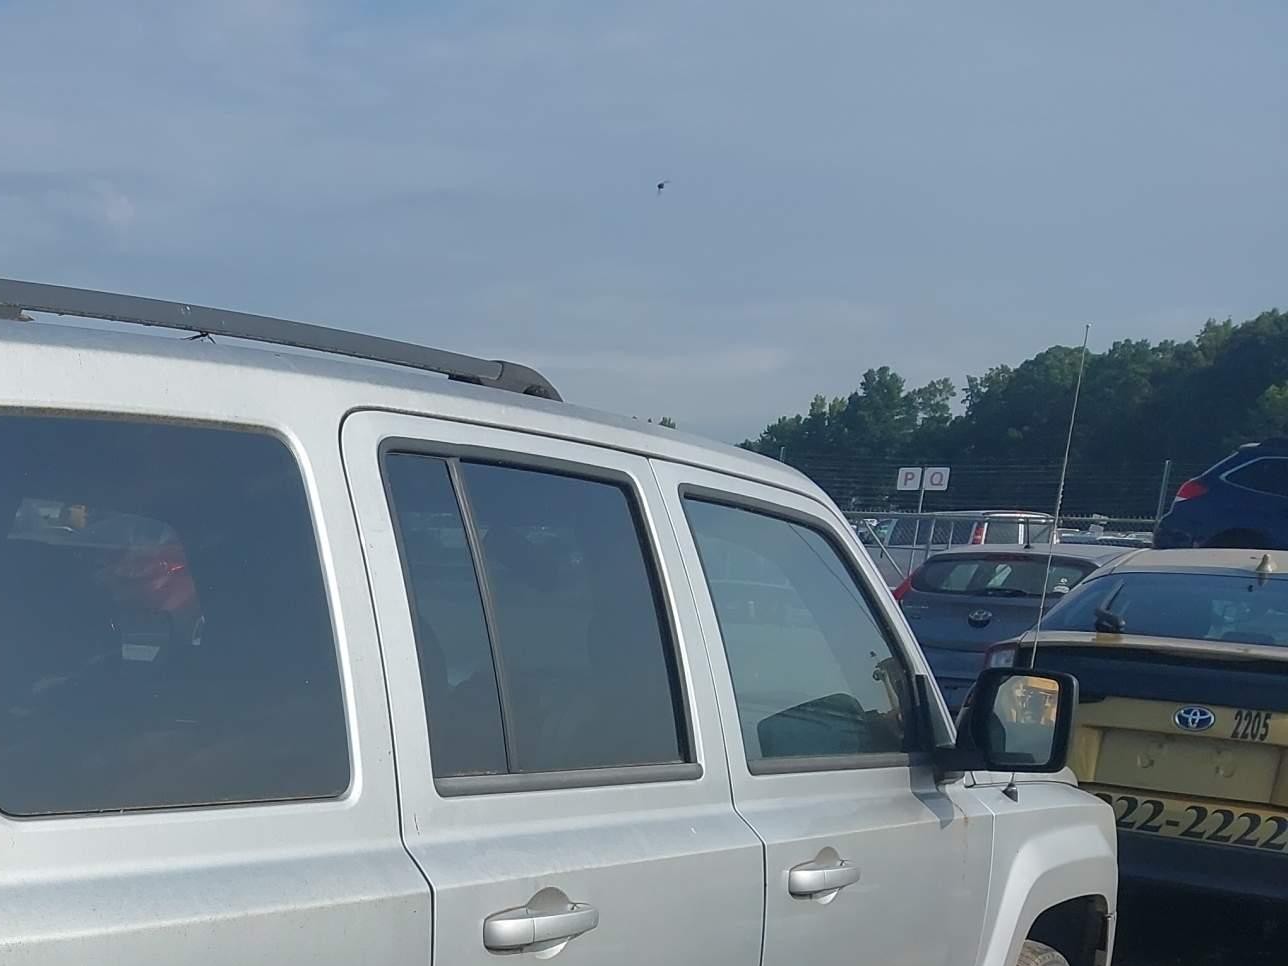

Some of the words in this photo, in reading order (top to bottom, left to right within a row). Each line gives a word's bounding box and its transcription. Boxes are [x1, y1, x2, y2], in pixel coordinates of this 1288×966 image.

[903, 472, 915, 487] P
[929, 471, 944, 487] Q
[1230, 709, 1272, 742] 2205
